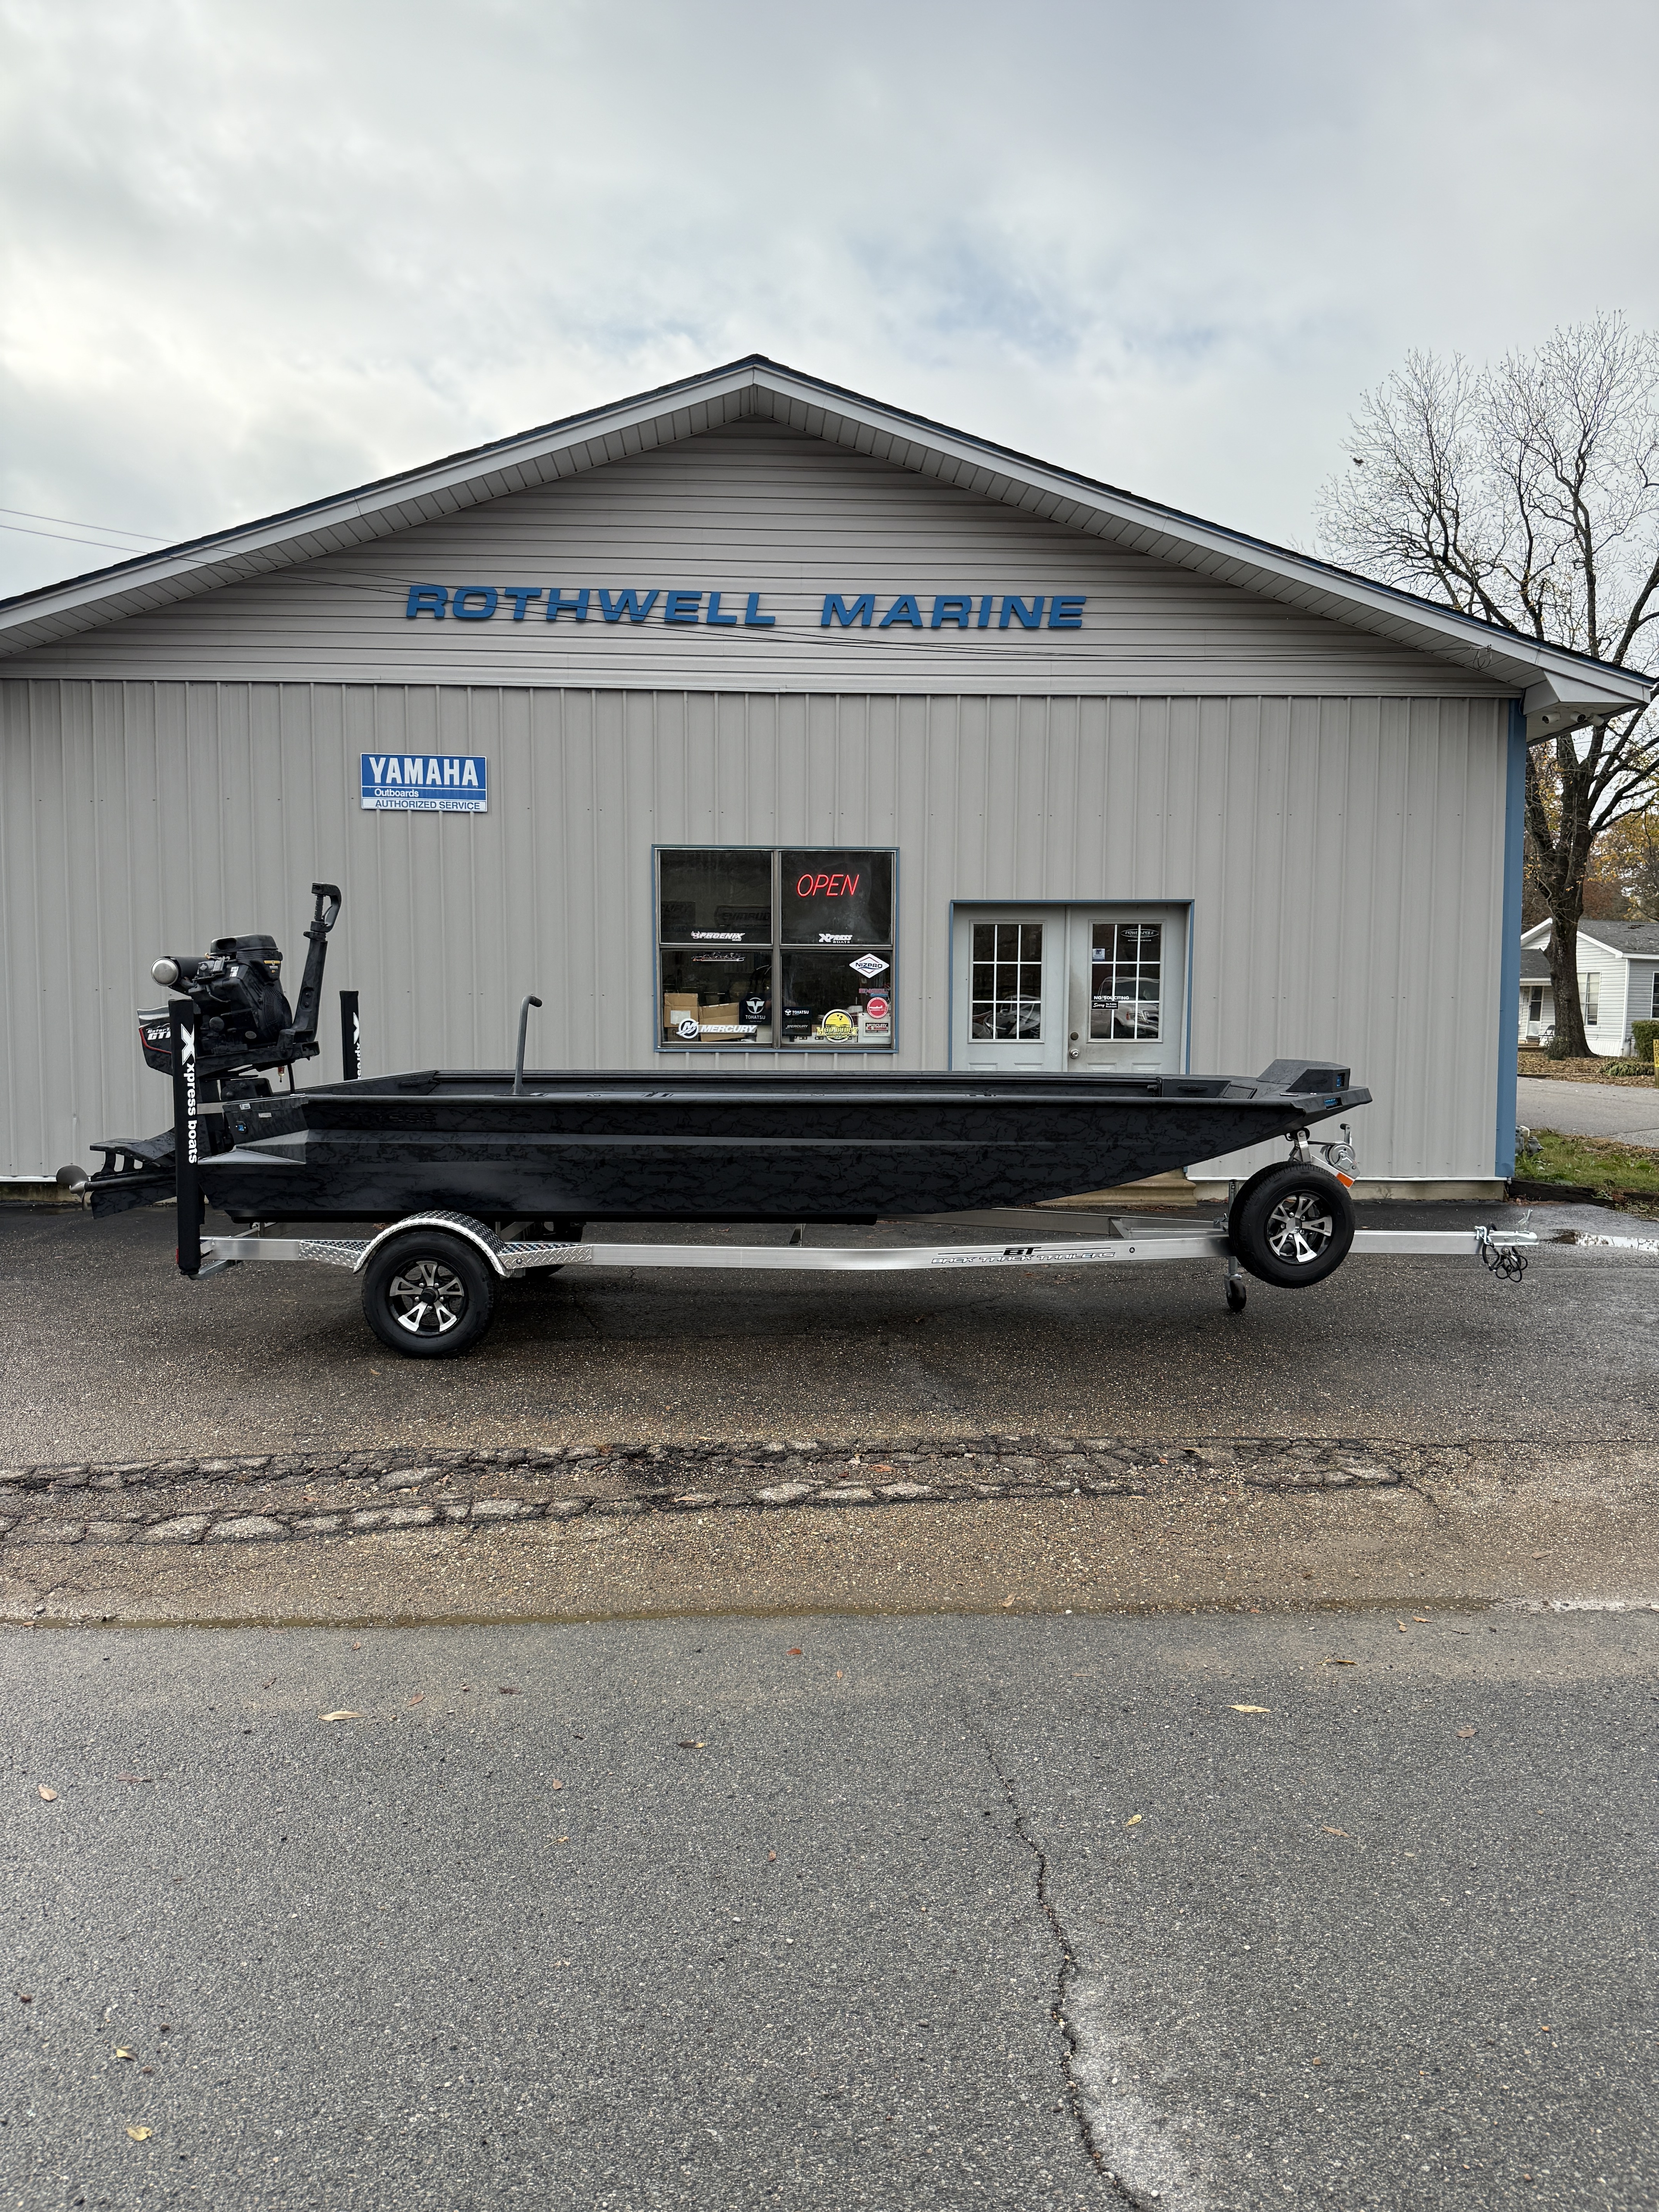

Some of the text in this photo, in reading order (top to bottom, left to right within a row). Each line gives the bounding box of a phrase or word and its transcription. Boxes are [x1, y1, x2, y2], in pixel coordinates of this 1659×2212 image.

[406, 585, 1086, 628] ROTHWELL MARINE
[369, 757, 479, 786] YAMAHA
[374, 788, 419, 797] Outboards
[375, 799, 481, 810] AUTHORIZED SERVICE
[797, 874, 860, 897] OPEN
[700, 1025, 757, 1033] MERCURY
[817, 1027, 859, 1036] MUD BUDDY
[184, 1063, 198, 1164] xpress boats
[1003, 1247, 1042, 1256] BT
[1037, 1252, 1116, 1261] TRAILERS
